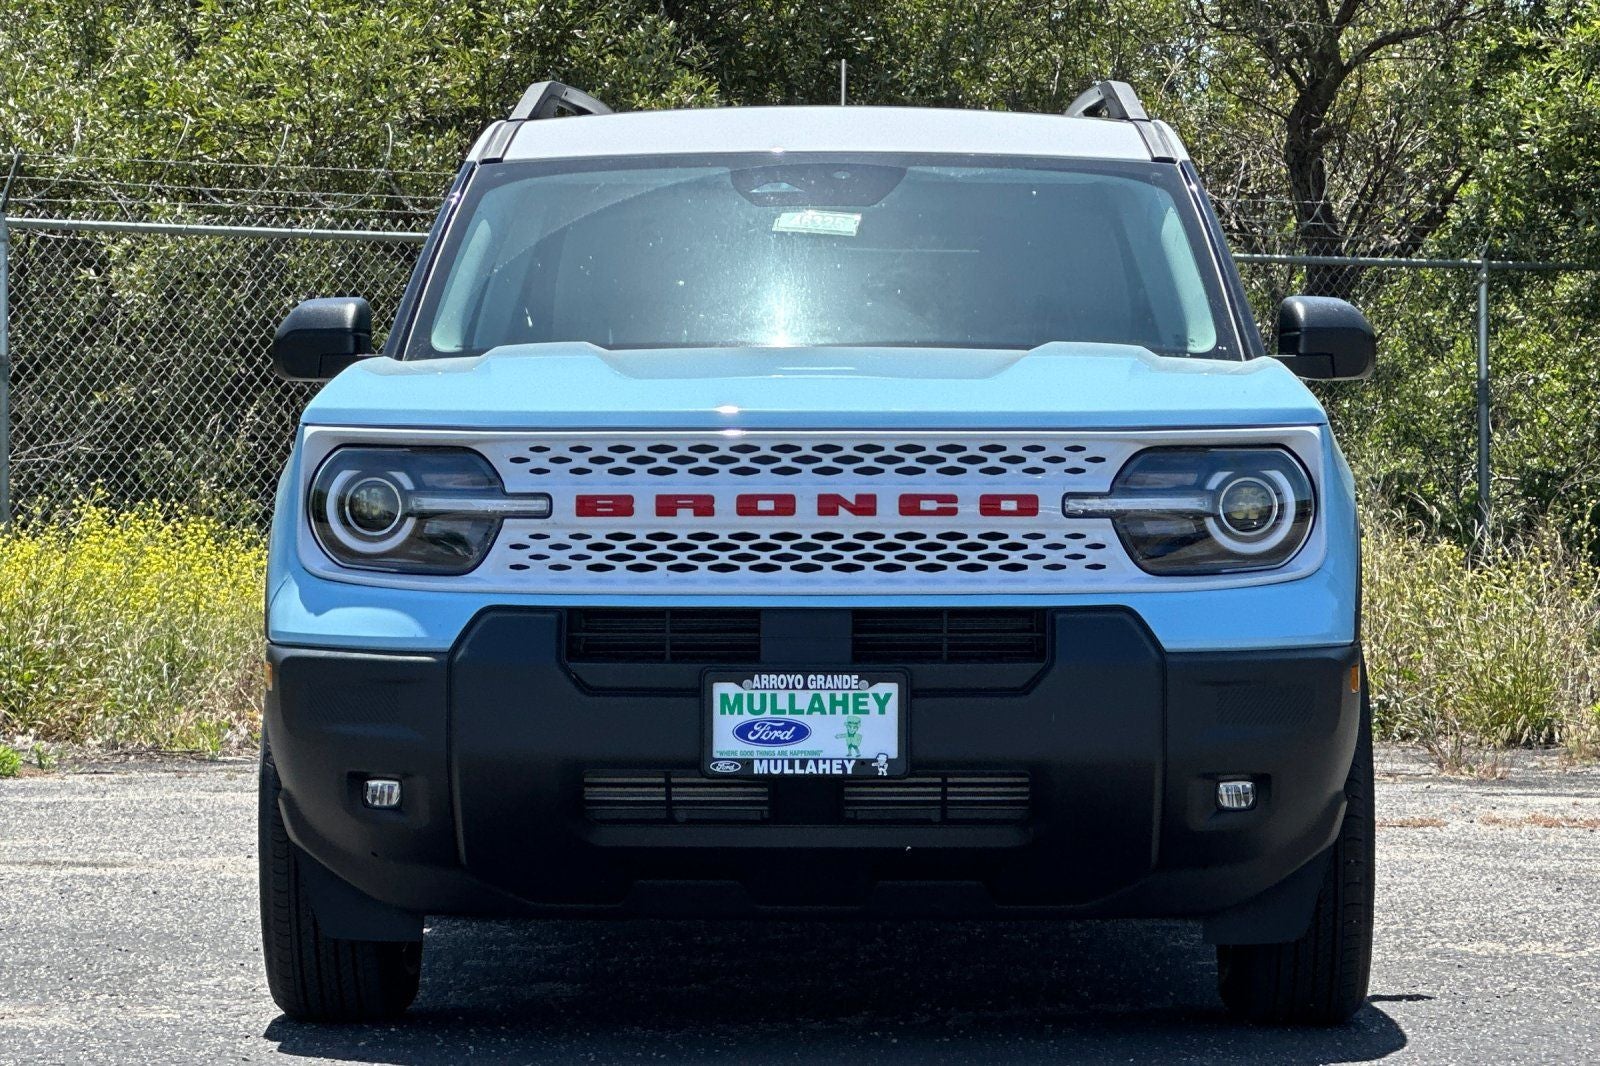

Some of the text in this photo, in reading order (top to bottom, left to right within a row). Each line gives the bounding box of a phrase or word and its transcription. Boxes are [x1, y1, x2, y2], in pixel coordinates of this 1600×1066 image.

[575, 493, 1039, 517] BRONCO
[752, 674, 859, 689] ARROYO GRANDE
[719, 693, 893, 715] MULLAHEY
[747, 721, 796, 740] Ford
[753, 759, 857, 774] MULLAHEY
